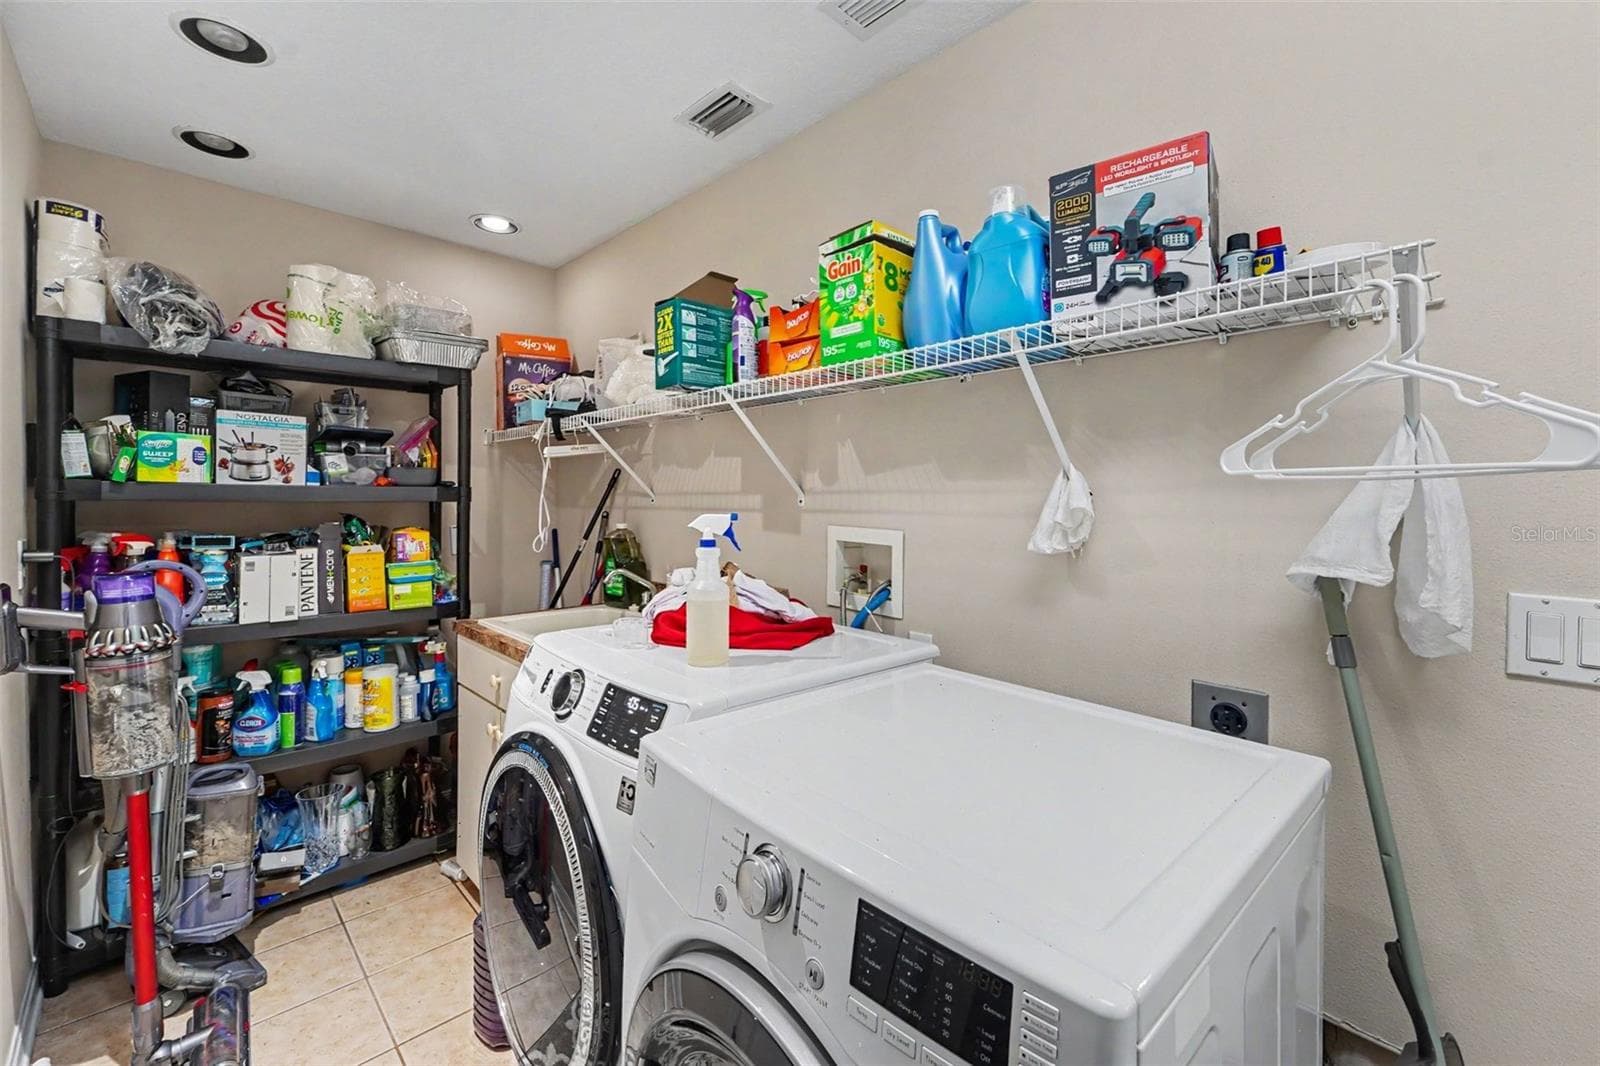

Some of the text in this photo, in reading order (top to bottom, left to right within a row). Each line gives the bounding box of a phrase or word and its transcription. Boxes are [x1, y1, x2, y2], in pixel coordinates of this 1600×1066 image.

[1100, 174, 1113, 183] LED
[1161, 149, 1200, 166] SPOTLIGHT
[1110, 143, 1188, 173] RECHARGEABLE
[1057, 194, 1089, 211] 2000
[1057, 205, 1089, 218] LUMENS
[827, 254, 862, 281] Gain
[657, 312, 673, 333] 2X
[822, 346, 837, 357] 195
[533, 363, 557, 378] Coffee
[235, 412, 291, 423] NOSTALGIA
[301, 553, 315, 613] PANTENE
